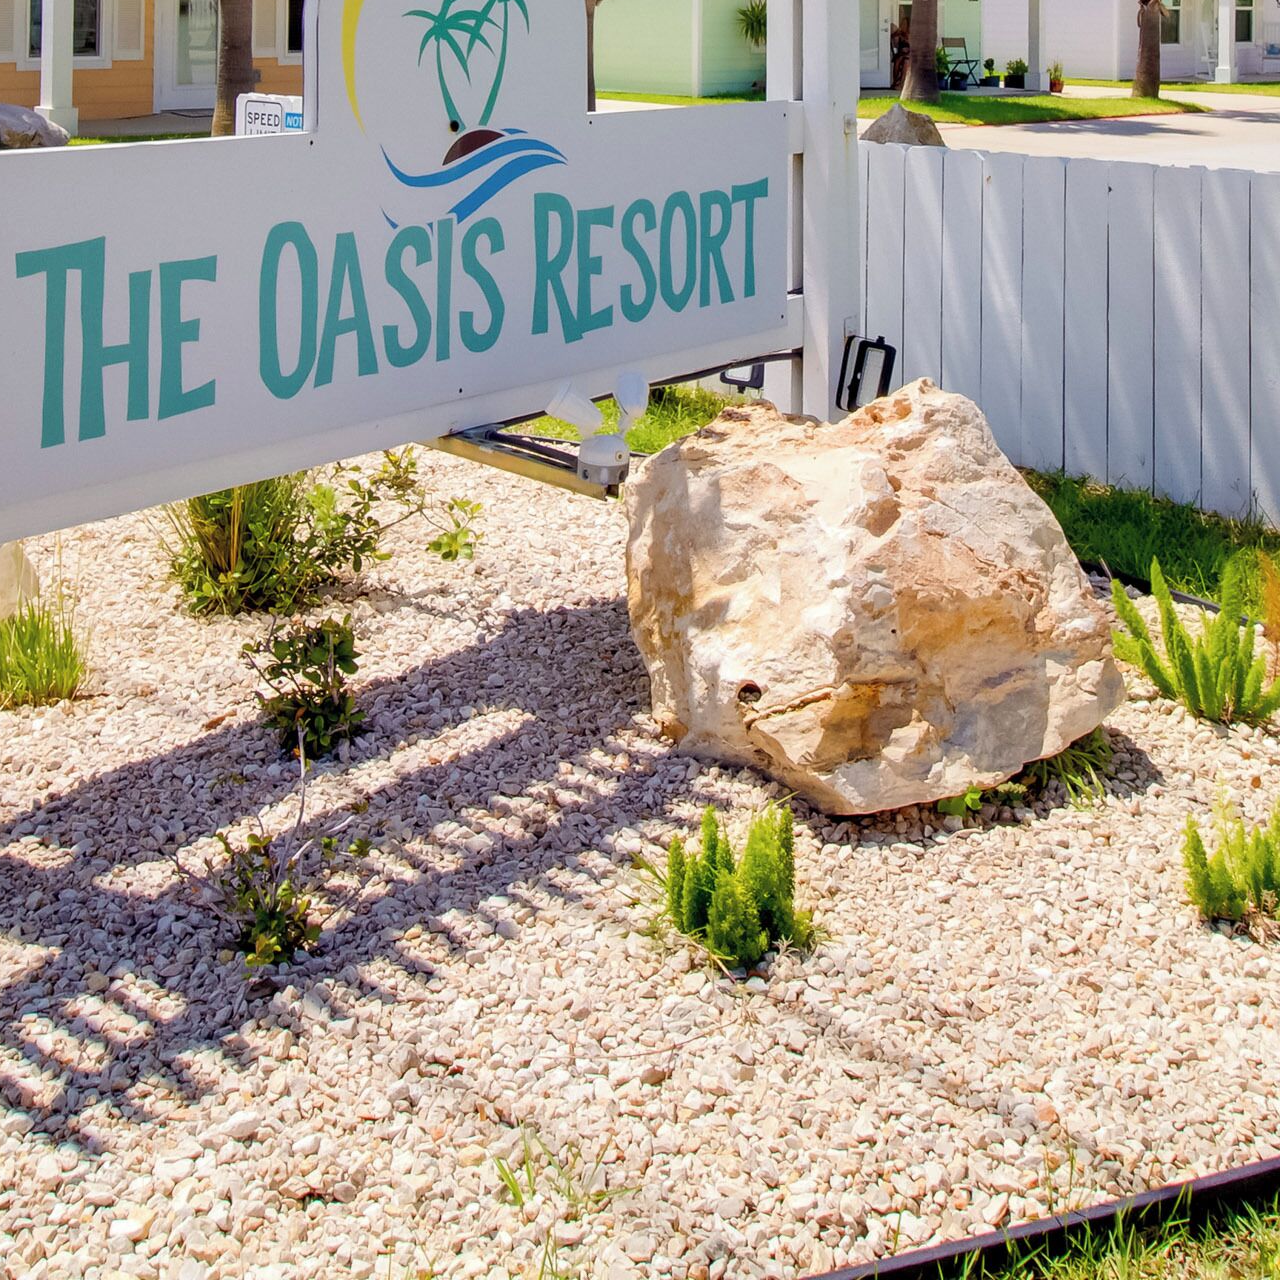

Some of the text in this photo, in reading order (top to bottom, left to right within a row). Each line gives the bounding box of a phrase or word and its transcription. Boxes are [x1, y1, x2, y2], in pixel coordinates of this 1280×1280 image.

[247, 111, 280, 127] SPEED
[15, 178, 769, 449] THE OASIS RESORT
